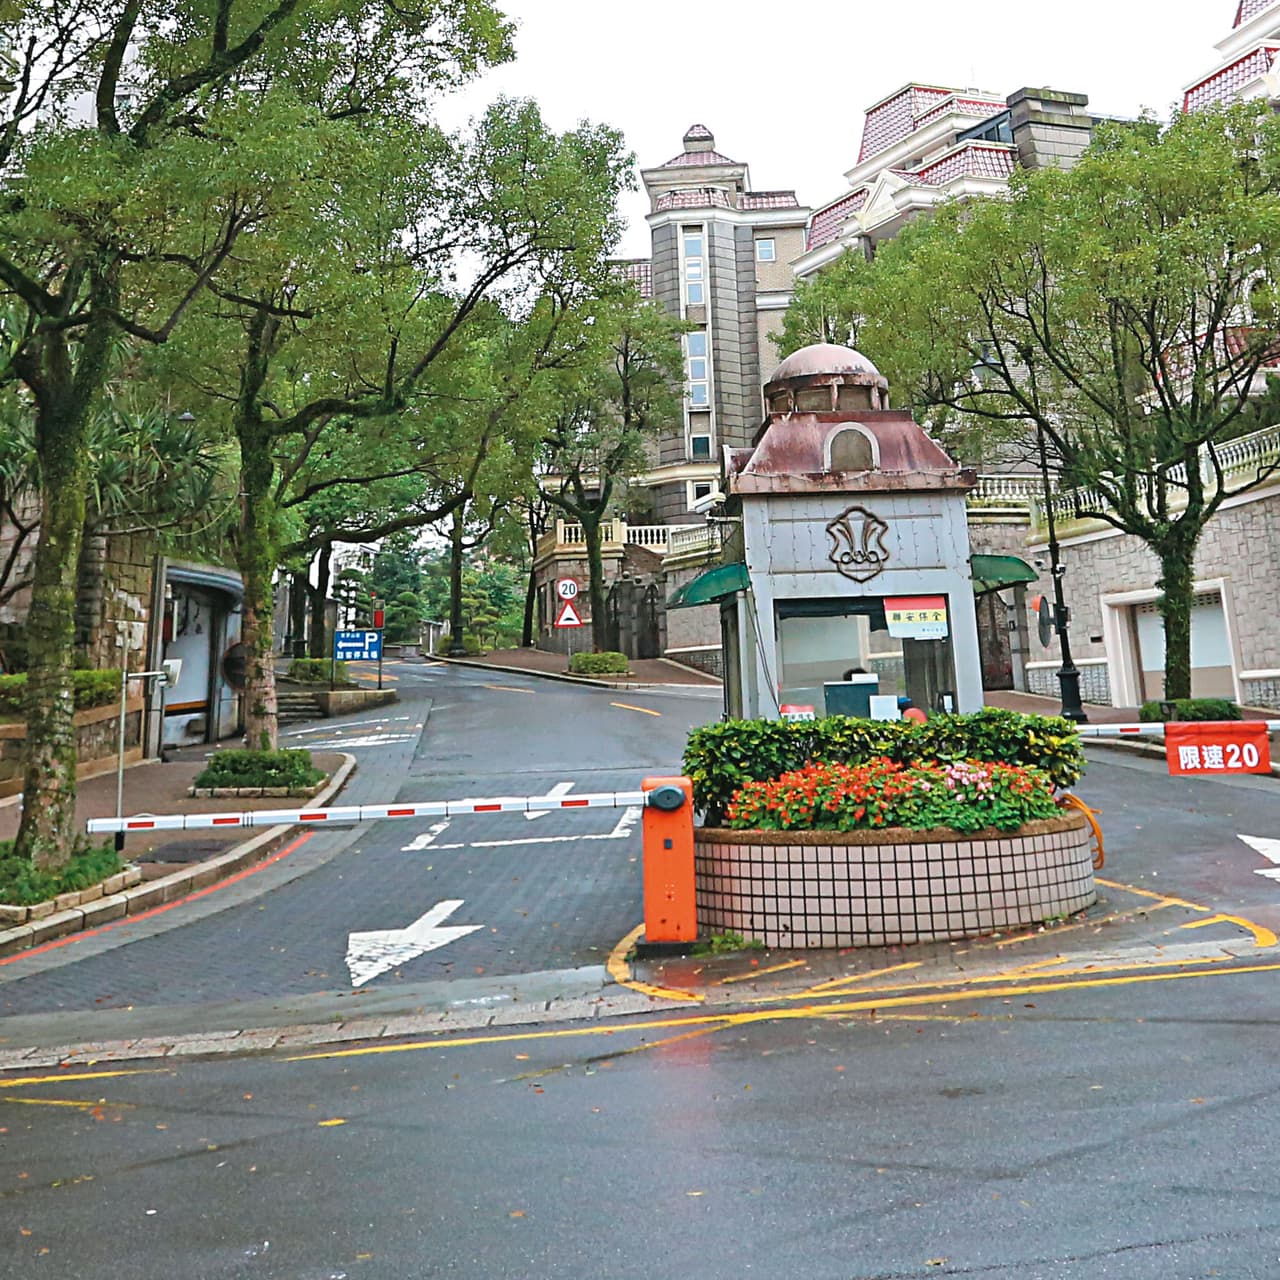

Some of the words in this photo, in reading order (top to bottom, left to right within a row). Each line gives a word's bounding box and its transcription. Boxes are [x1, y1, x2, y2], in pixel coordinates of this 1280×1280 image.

[562, 583, 576, 595] 20
[365, 632, 378, 650] P
[1178, 743, 1259, 770] 限速20
